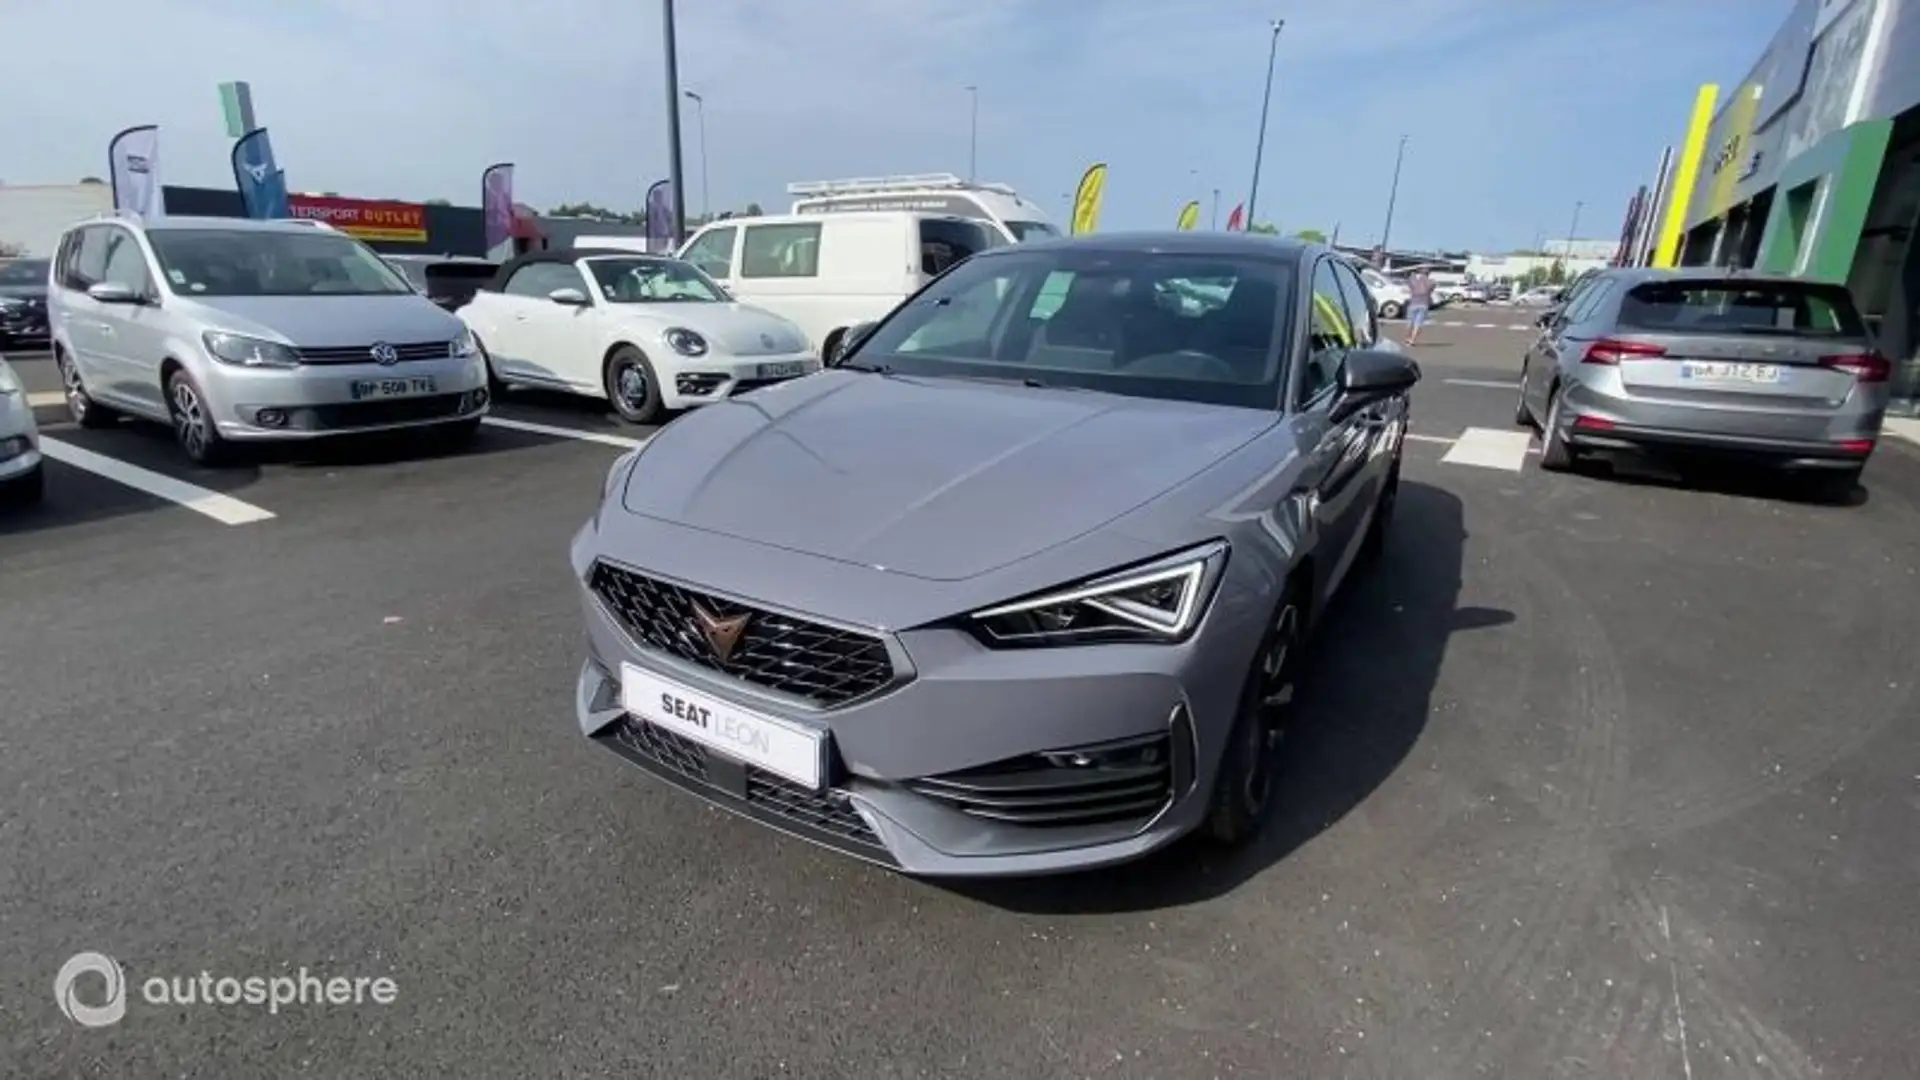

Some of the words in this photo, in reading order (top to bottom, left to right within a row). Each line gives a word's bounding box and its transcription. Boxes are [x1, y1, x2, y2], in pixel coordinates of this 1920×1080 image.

[365, 210, 420, 225] OUTLET
[662, 693, 711, 728] SEAT
[715, 713, 770, 753] LEON
